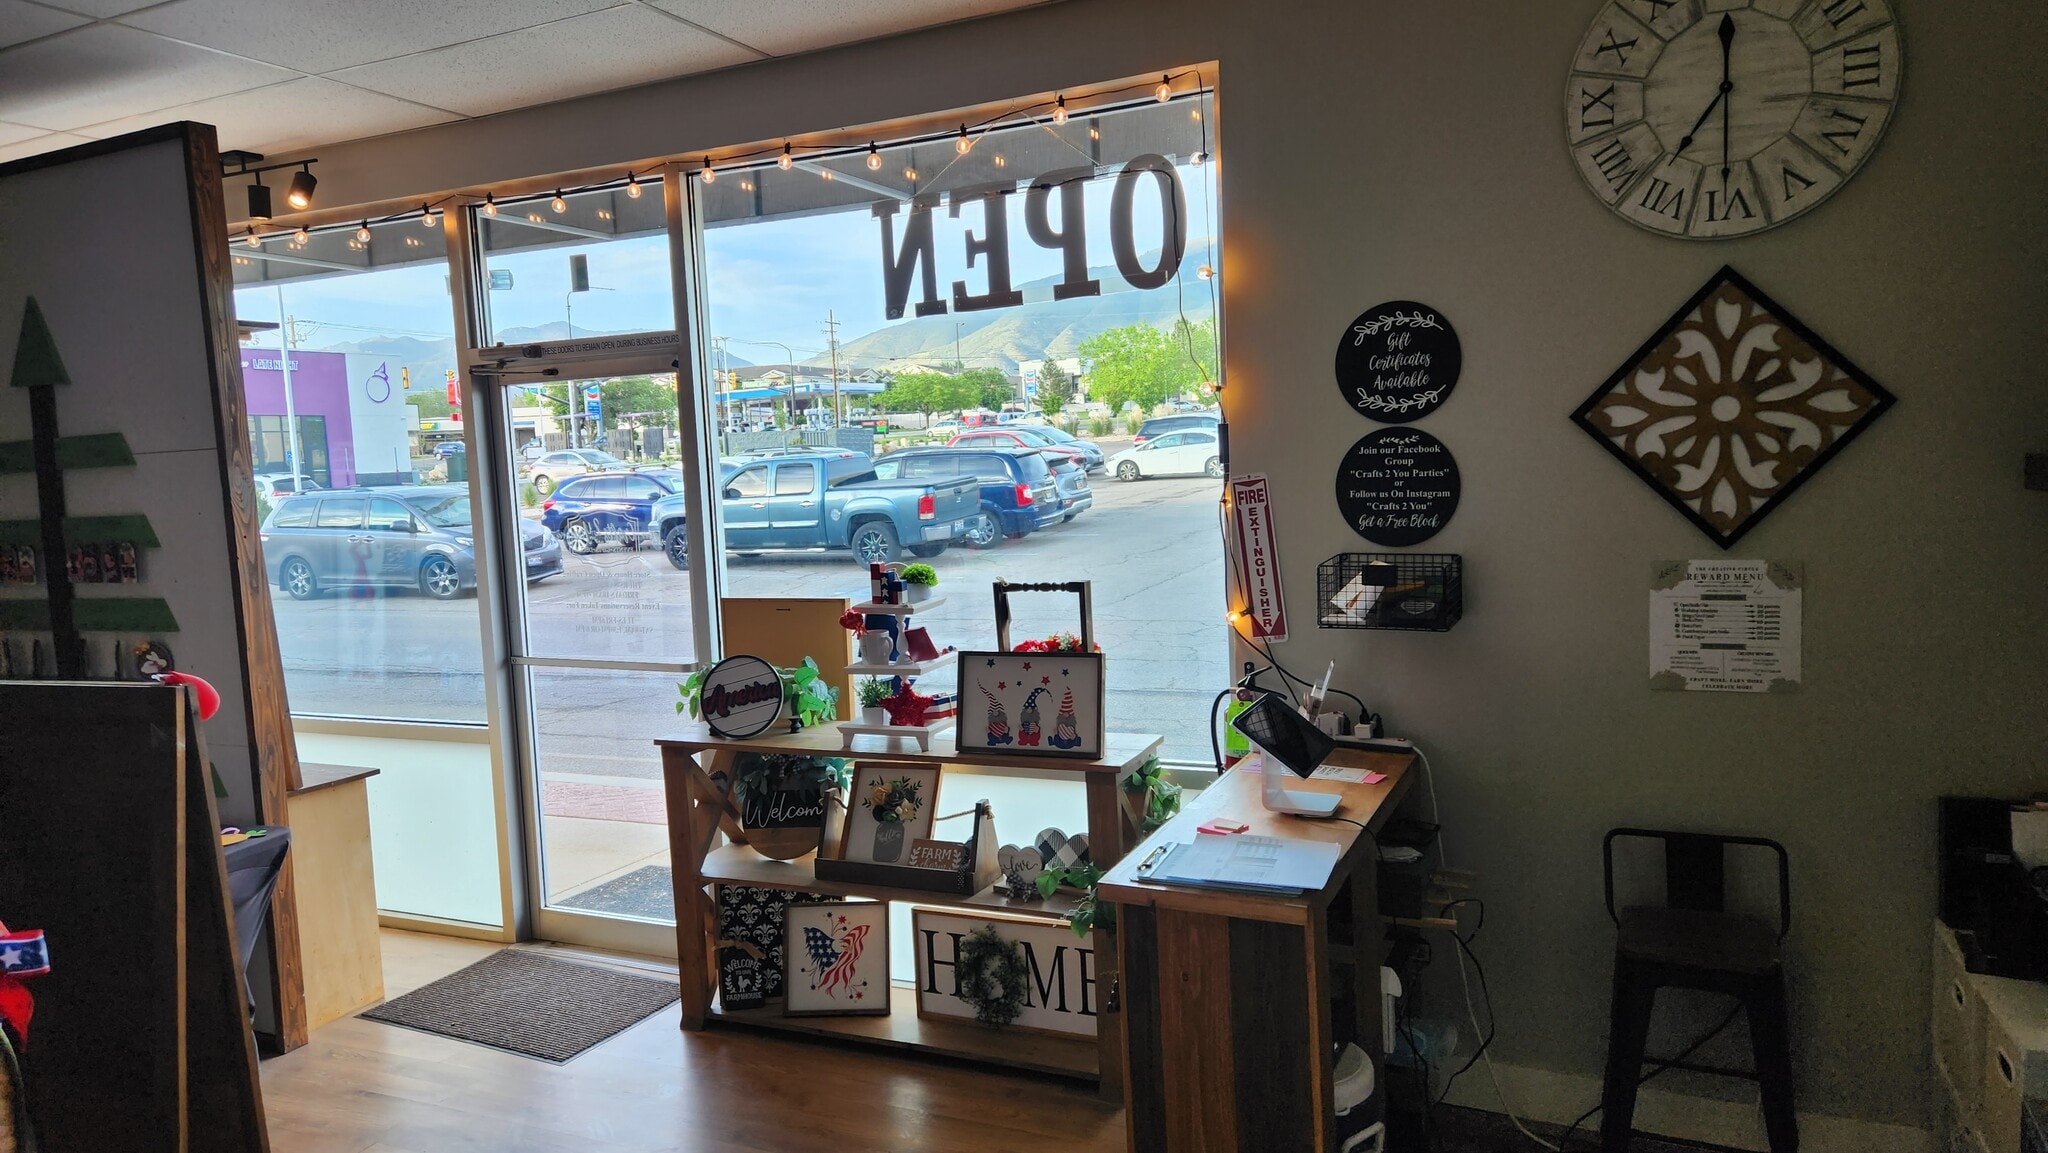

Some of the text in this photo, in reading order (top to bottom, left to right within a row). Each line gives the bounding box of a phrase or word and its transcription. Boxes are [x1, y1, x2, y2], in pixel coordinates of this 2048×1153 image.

[1595, 27, 1639, 68] X
[1842, 41, 1881, 90] III
[1581, 82, 1616, 132] IX
[1821, 109, 1869, 157] IV
[1638, 176, 1687, 221] VII
[1704, 186, 1757, 223] VI
[542, 334, 680, 355] THESE DOORS TO REMAIN OPEN DURING BUSINESS HOURS
[1387, 331, 1412, 352] Gift
[252, 358, 299, 371] LATE NIHT
[1368, 351, 1433, 372] Certificates
[1372, 370, 1431, 391] Available
[1358, 446, 1378, 455] Join
[1398, 445, 1441, 454] Facebook
[1384, 457, 1414, 467] Group
[1350, 469, 1383, 479] "Crafts
[1392, 469, 1410, 477] You
[1412, 468, 1450, 477] Parties"
[1237, 487, 1266, 506] FIRE
[1350, 490, 1377, 498] Follow
[1391, 490, 1404, 498] On
[1406, 490, 1450, 499] Instagram
[1366, 502, 1433, 510] "Crafts 2 You"
[1358, 513, 1441, 531] Get a Free Block
[1248, 507, 1273, 628] EXTINGUISHER
[1686, 573, 1764, 581] REWARD MENU
[702, 681, 781, 718] America
[745, 791, 823, 828] Welcom
[921, 847, 952, 861] FARM
[1002, 855, 1038, 873] love
[724, 958, 762, 973] WELCOME
[920, 929, 1096, 1016] HME
[726, 992, 762, 1001] FARMHOUSE
